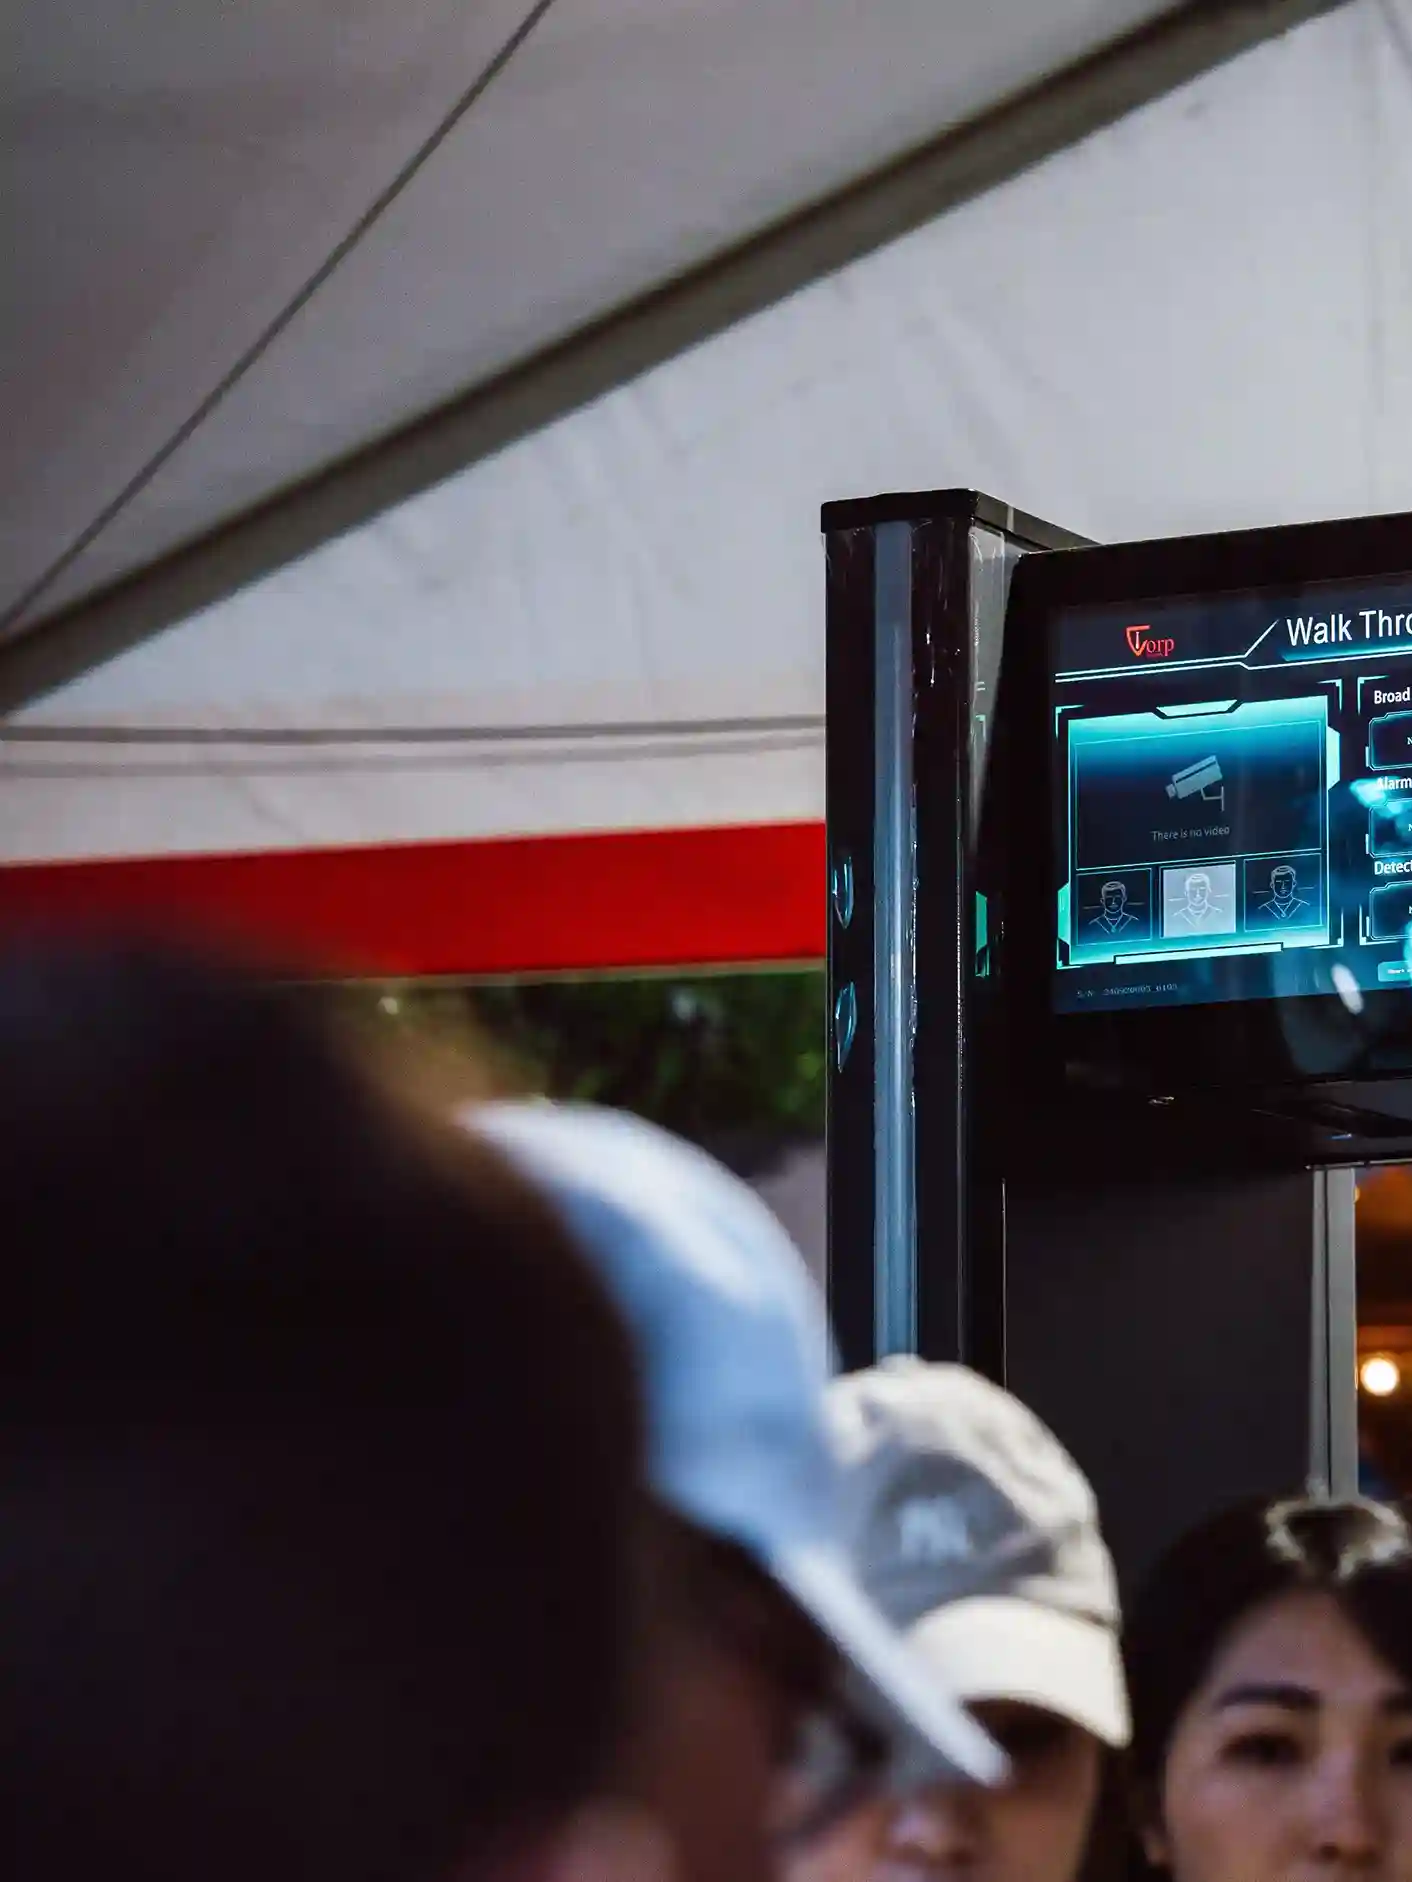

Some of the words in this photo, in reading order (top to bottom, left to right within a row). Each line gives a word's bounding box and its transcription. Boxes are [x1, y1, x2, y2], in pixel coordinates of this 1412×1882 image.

[1286, 613, 1352, 646] Walk
[1374, 686, 1411, 704] Broad
[1376, 776, 1412, 790] Alarm
[1149, 830, 1179, 841] There
[1203, 825, 1230, 836] video
